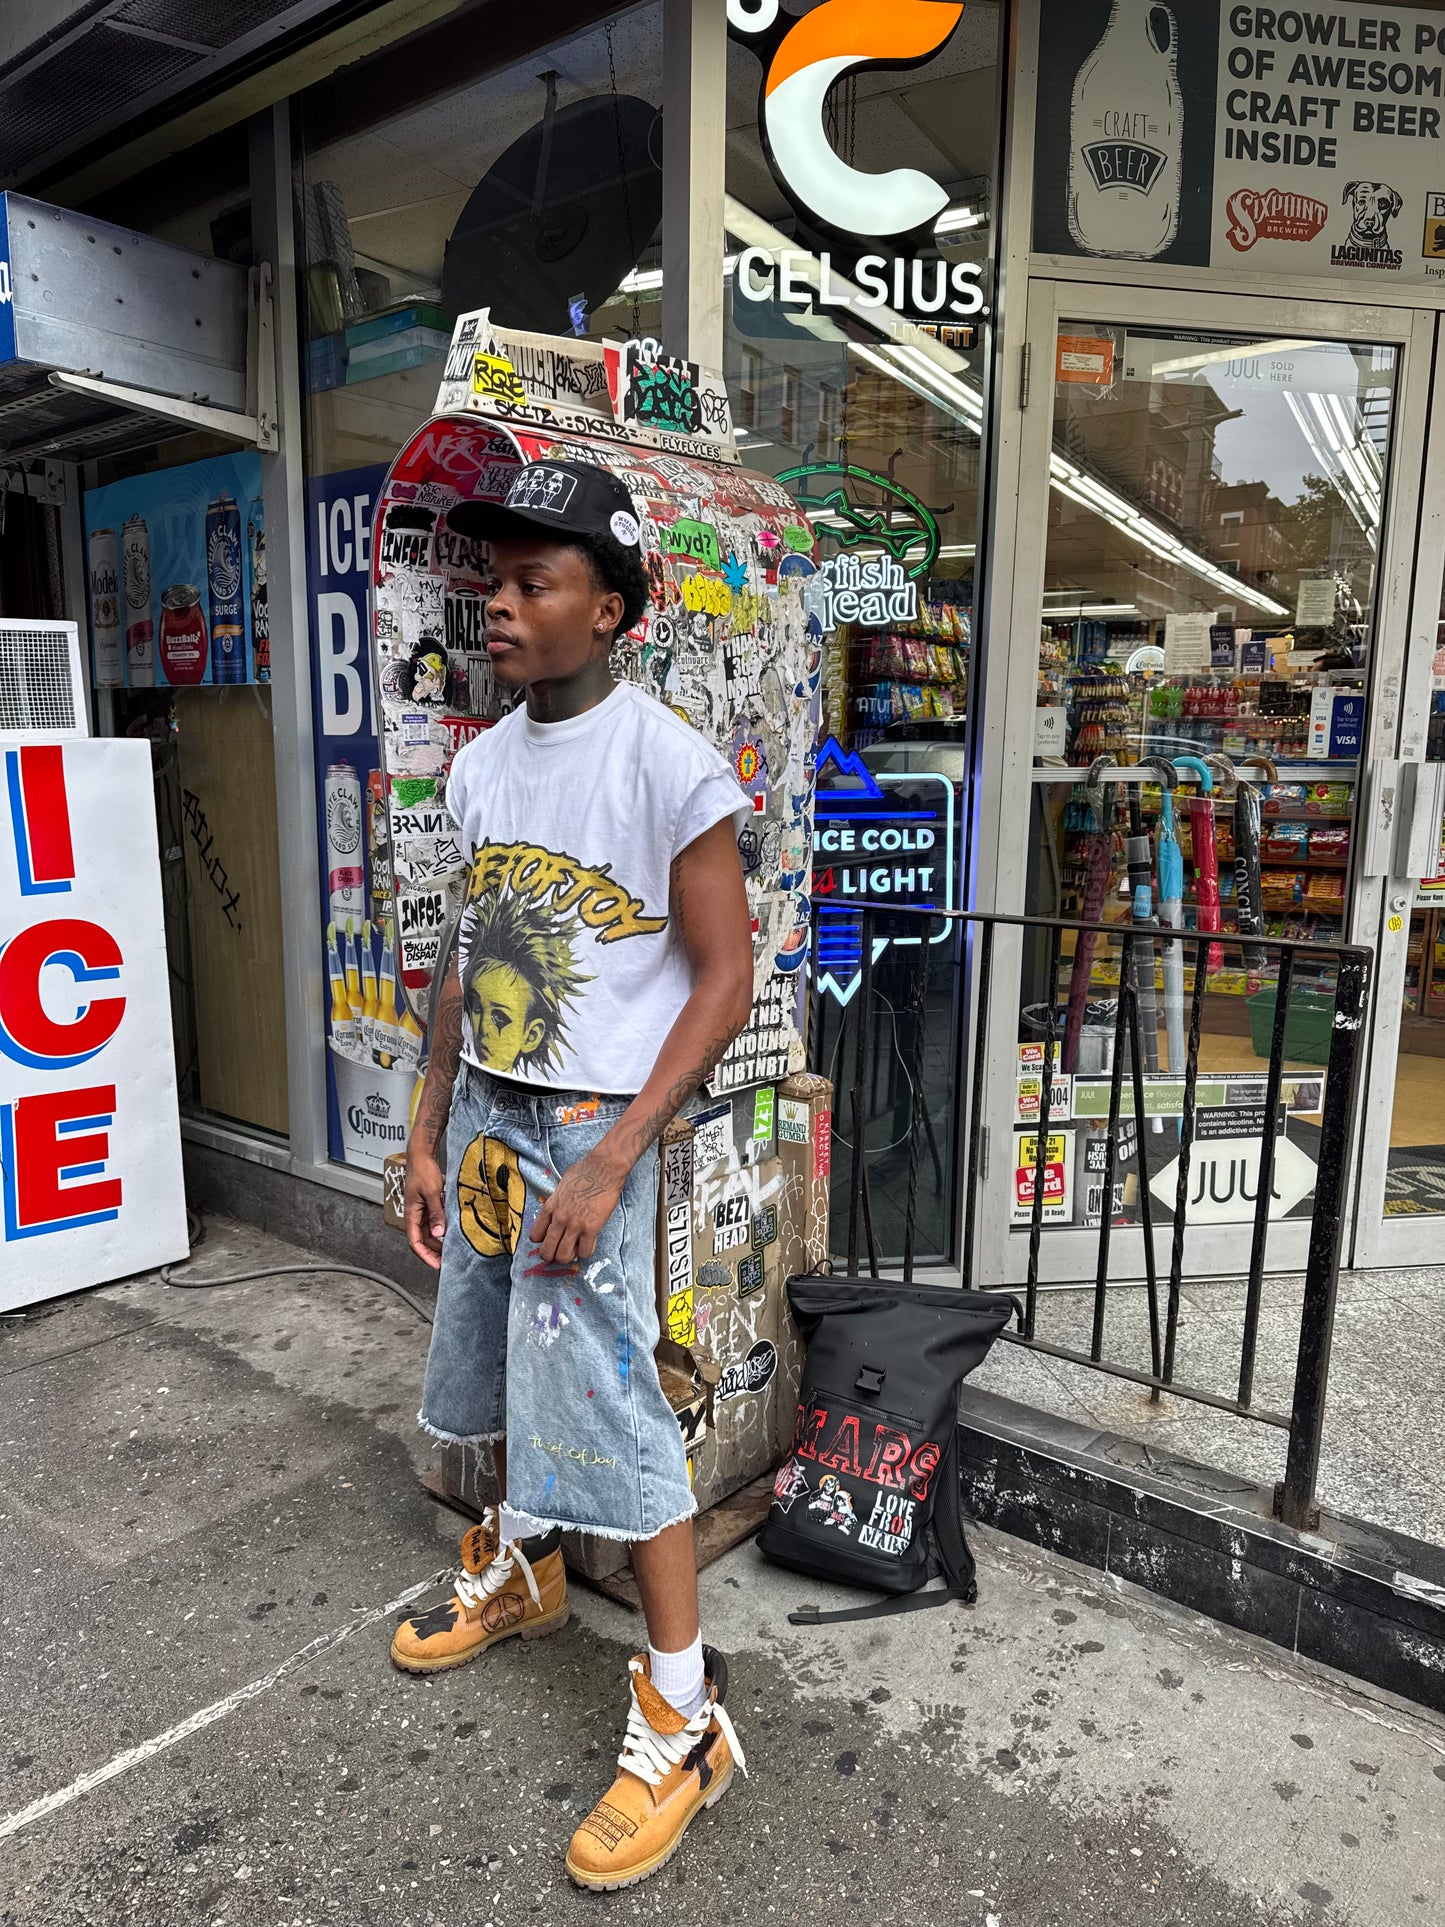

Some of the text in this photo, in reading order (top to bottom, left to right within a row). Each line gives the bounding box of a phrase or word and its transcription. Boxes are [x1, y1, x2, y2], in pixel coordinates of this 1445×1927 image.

[1229, 5, 1401, 52] GROWLER
[1228, 47, 1445, 98] OF AWESOM
[1103, 110, 1150, 139] CRAFT
[1226, 89, 1441, 139] CRAFT BEER
[1225, 128, 1337, 168] INSIDE
[1099, 150, 1150, 185] BEER
[1266, 225, 1310, 236] BREWERY
[1330, 244, 1403, 265] LAGUNITAS
[1330, 259, 1402, 271] BREWING COMPANY
[890, 321, 973, 347] LIVE FIT
[1270, 361, 1294, 371] SOLD
[1269, 373, 1294, 382] HERE
[669, 532, 712, 556] wyd?
[215, 603, 238, 616] SURGE
[1335, 735, 1357, 745] VISA
[337, 787, 359, 810] CLAW
[813, 828, 936, 852] ICE COLD
[1416, 893, 1444, 902] Please Have
[0, 745, 126, 1241] ICE
[334, 1029, 355, 1041] Corona
[1021, 1063, 1031, 1071] We
[347, 1105, 406, 1141] Corona
[1198, 1118, 1256, 1128] contains nicotine.
[1202, 1110, 1238, 1119] WARNING:
[1238, 1110, 1254, 1118] This
[1048, 1137, 1056, 1146] 21
[1200, 1128, 1208, 1136] is
[1218, 1126, 1248, 1135] addictive
[1025, 1146, 1034, 1155] No
[1013, 1208, 1066, 1218] Please ID Ready
[713, 1225, 749, 1256] HEAD
[786, 1404, 941, 1501] MARS
[873, 1490, 916, 1520] LOVE
[867, 1507, 913, 1540] FROM
